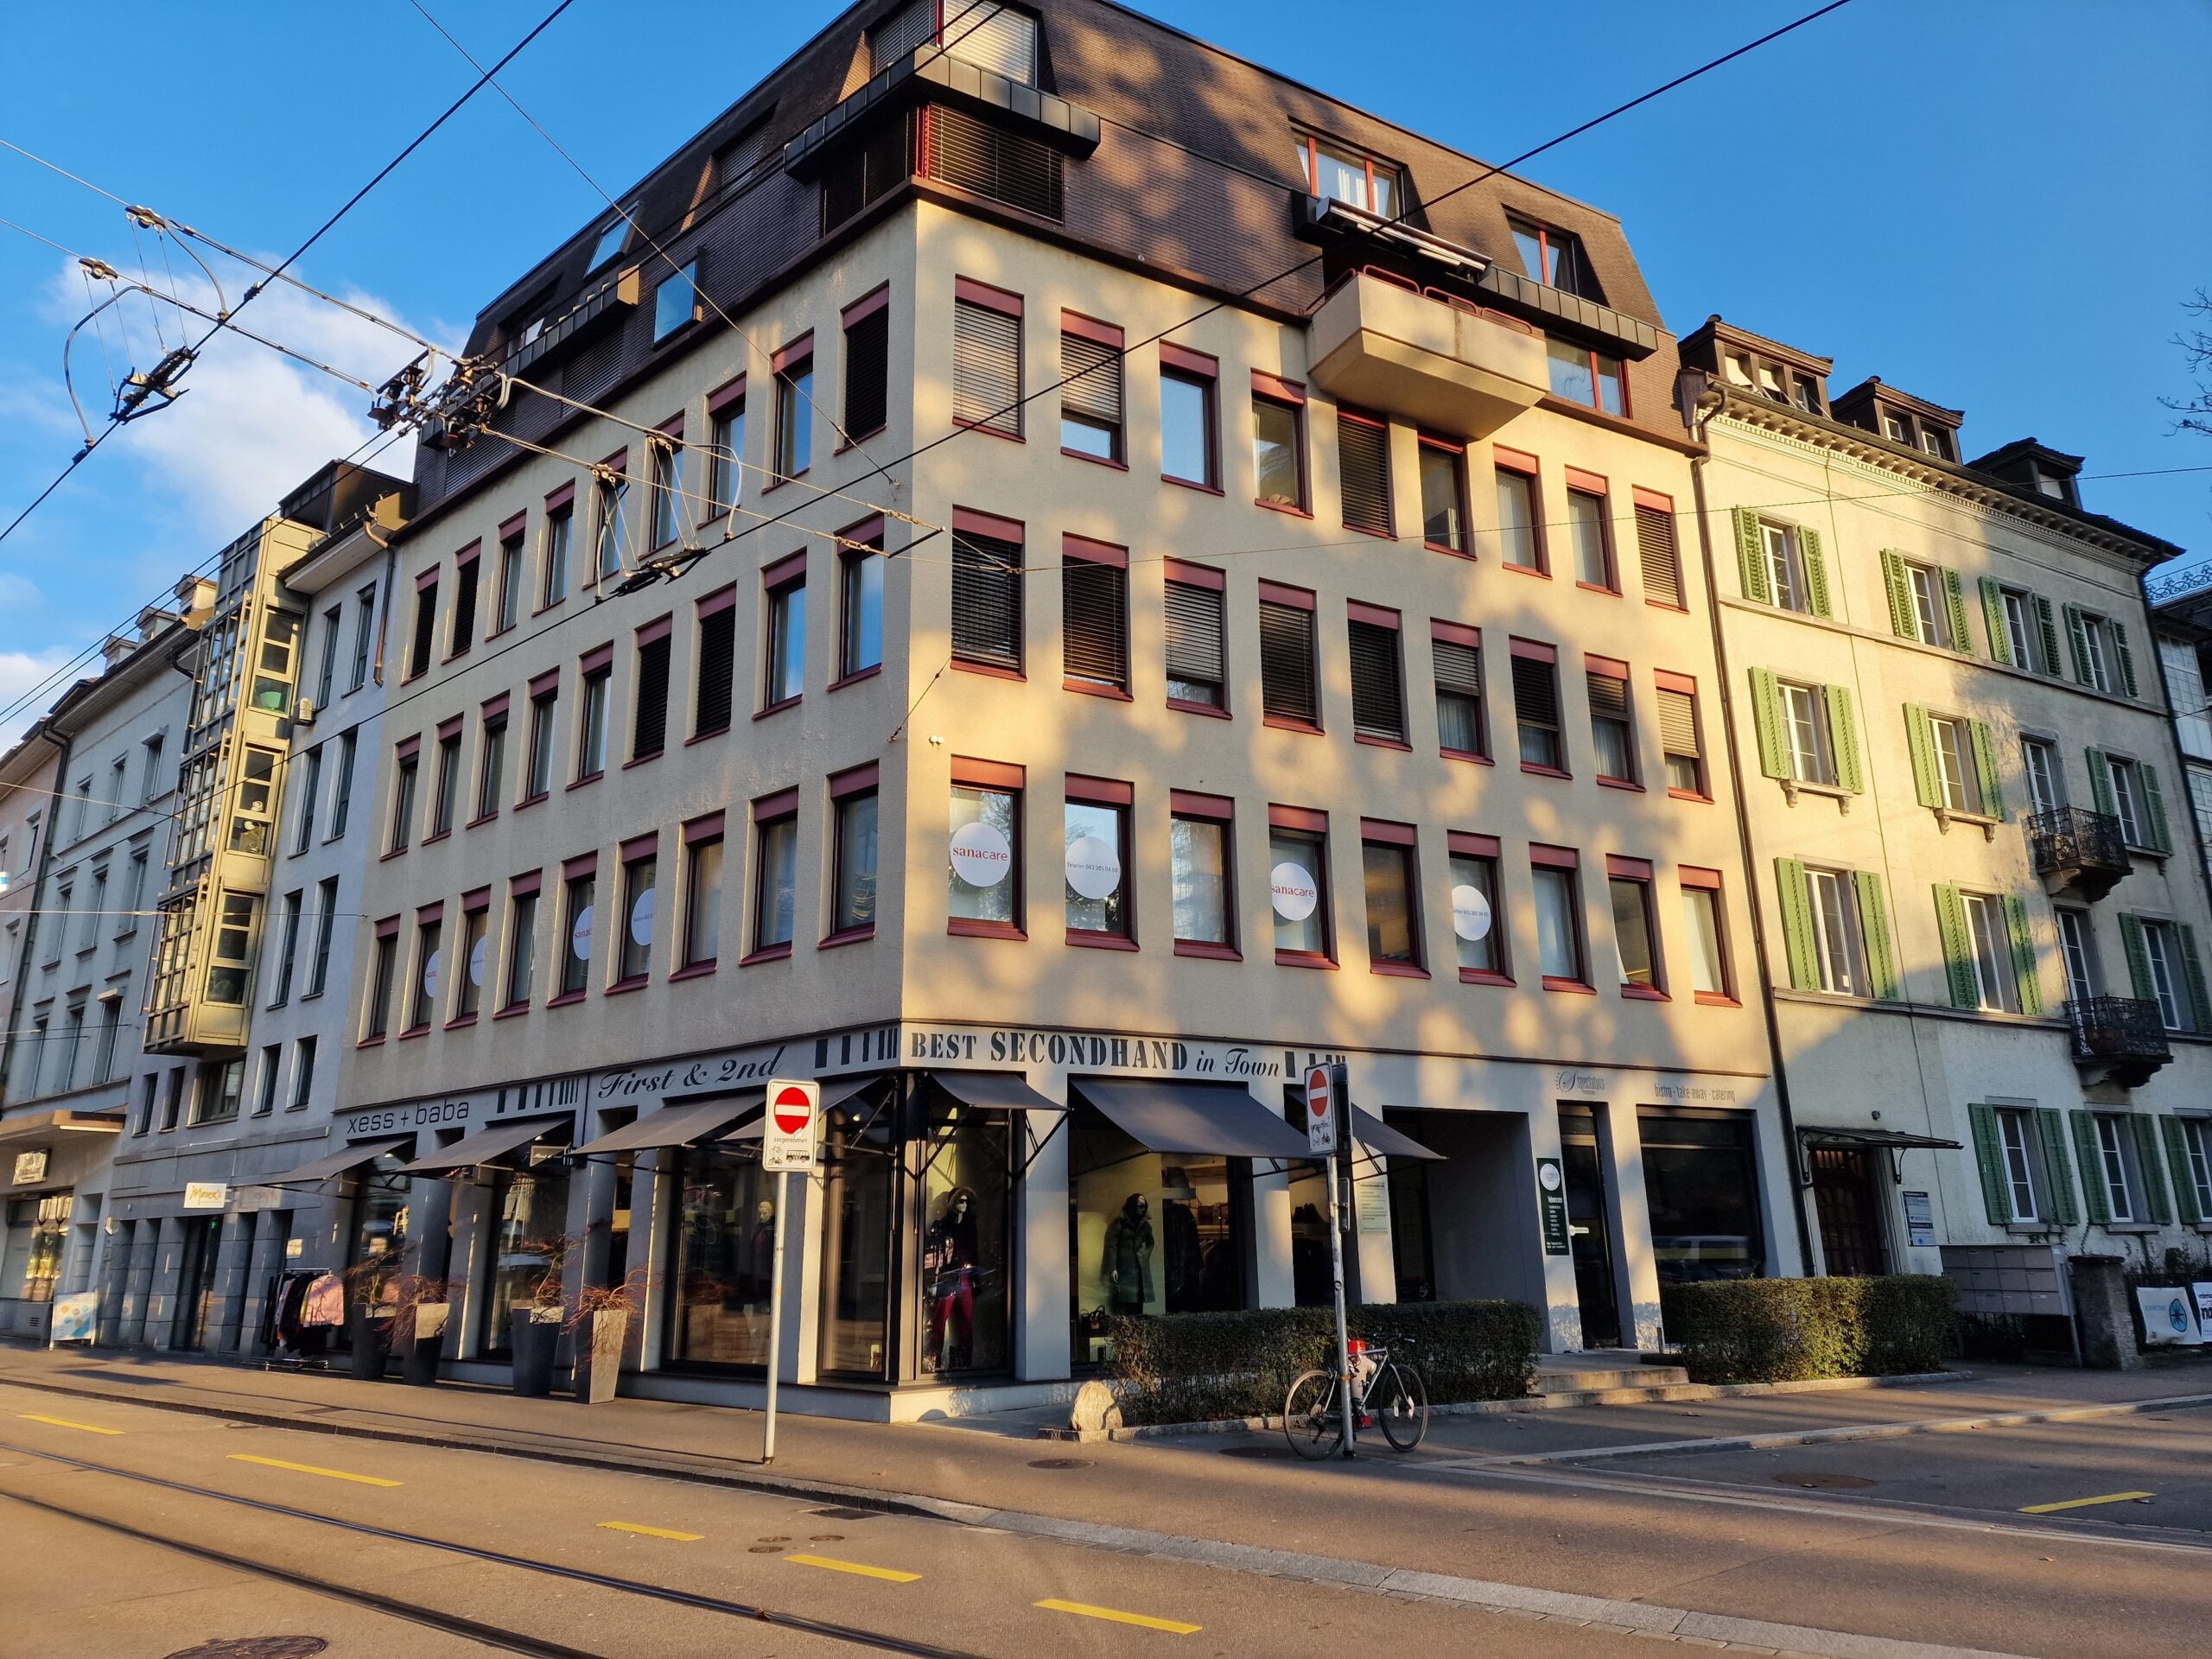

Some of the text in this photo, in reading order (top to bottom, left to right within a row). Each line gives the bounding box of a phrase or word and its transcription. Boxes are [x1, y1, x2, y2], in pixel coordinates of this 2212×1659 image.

[952, 847, 1007, 861] sanacare
[911, 1031, 1281, 1077] BEST SECONDHAND in Town
[598, 1046, 786, 1099] First & 2nd
[1655, 1084, 1673, 1097] bistro
[1676, 1085, 1707, 1102] take-away
[1712, 1088, 1736, 1103] catering
[346, 1099, 469, 1134] xess + baba
